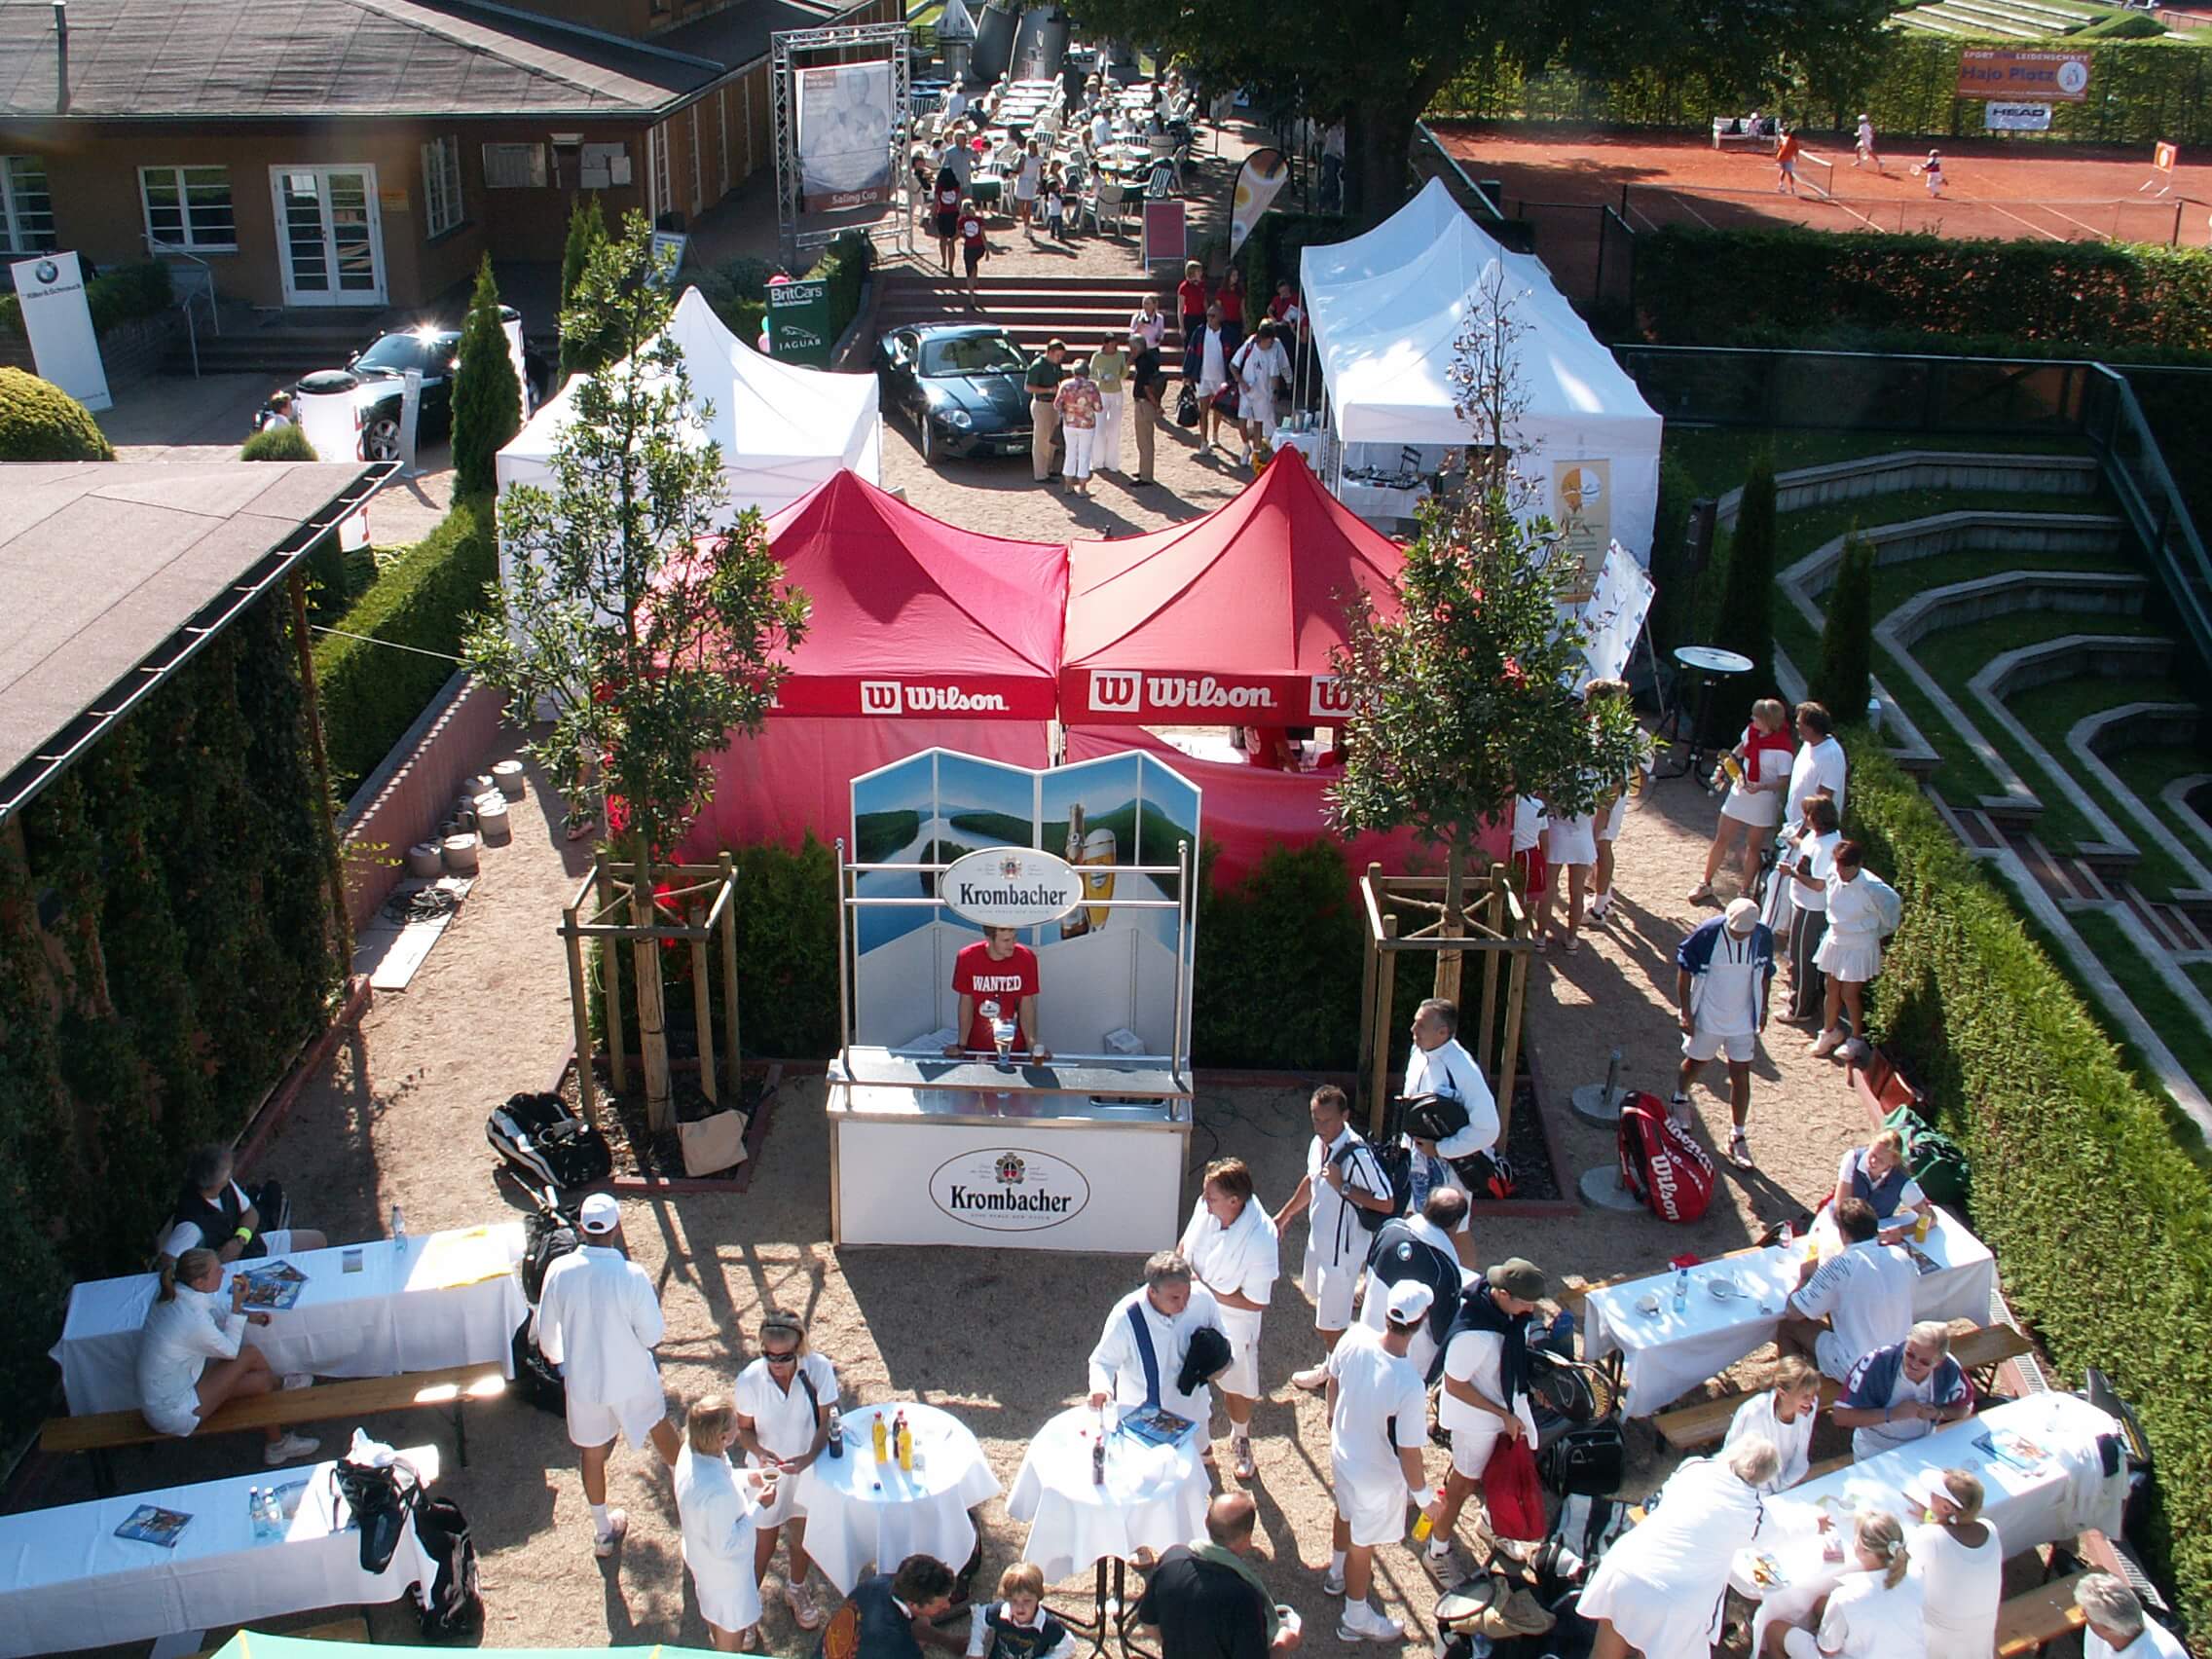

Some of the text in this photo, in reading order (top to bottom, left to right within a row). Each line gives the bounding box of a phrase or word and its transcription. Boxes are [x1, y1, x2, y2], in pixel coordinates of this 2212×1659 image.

[1962, 67, 2003, 81] Hajo
[1992, 108, 2046, 117] HEAD
[770, 285, 824, 302] BritCars
[904, 685, 1006, 711] Wilson
[1146, 676, 1274, 709] Wilson
[959, 882, 1068, 906] Krombacher
[973, 975, 1022, 992] WANTED
[950, 1184, 1073, 1213] Krombacher
[1650, 1154, 1680, 1221] Wilson
